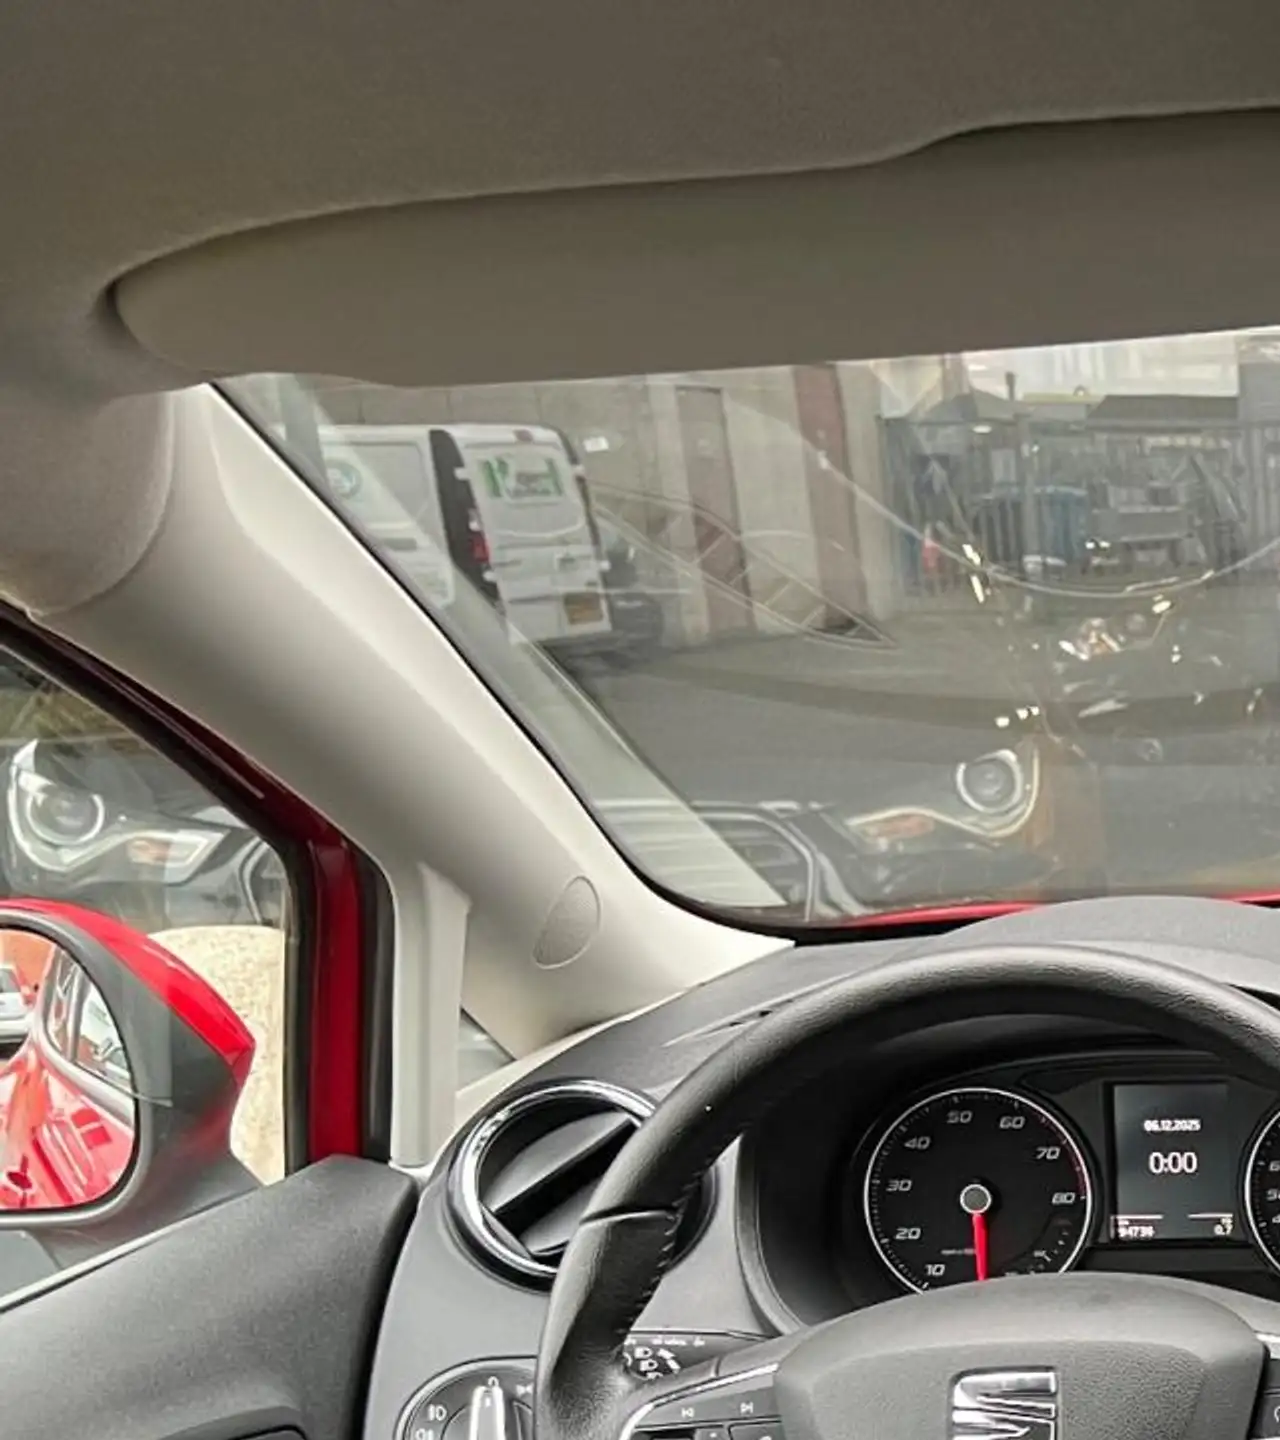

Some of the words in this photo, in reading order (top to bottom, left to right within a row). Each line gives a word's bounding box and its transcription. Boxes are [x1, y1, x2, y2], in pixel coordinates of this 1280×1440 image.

[946, 1110, 973, 1125] 50
[999, 1115, 1026, 1130] 60
[904, 1135, 931, 1150] 40
[1036, 1145, 1061, 1160] 70
[1149, 1151, 1198, 1174] 0:00
[885, 1178, 912, 1193] 30
[895, 1226, 922, 1241] 20
[923, 1263, 946, 1277] 10
